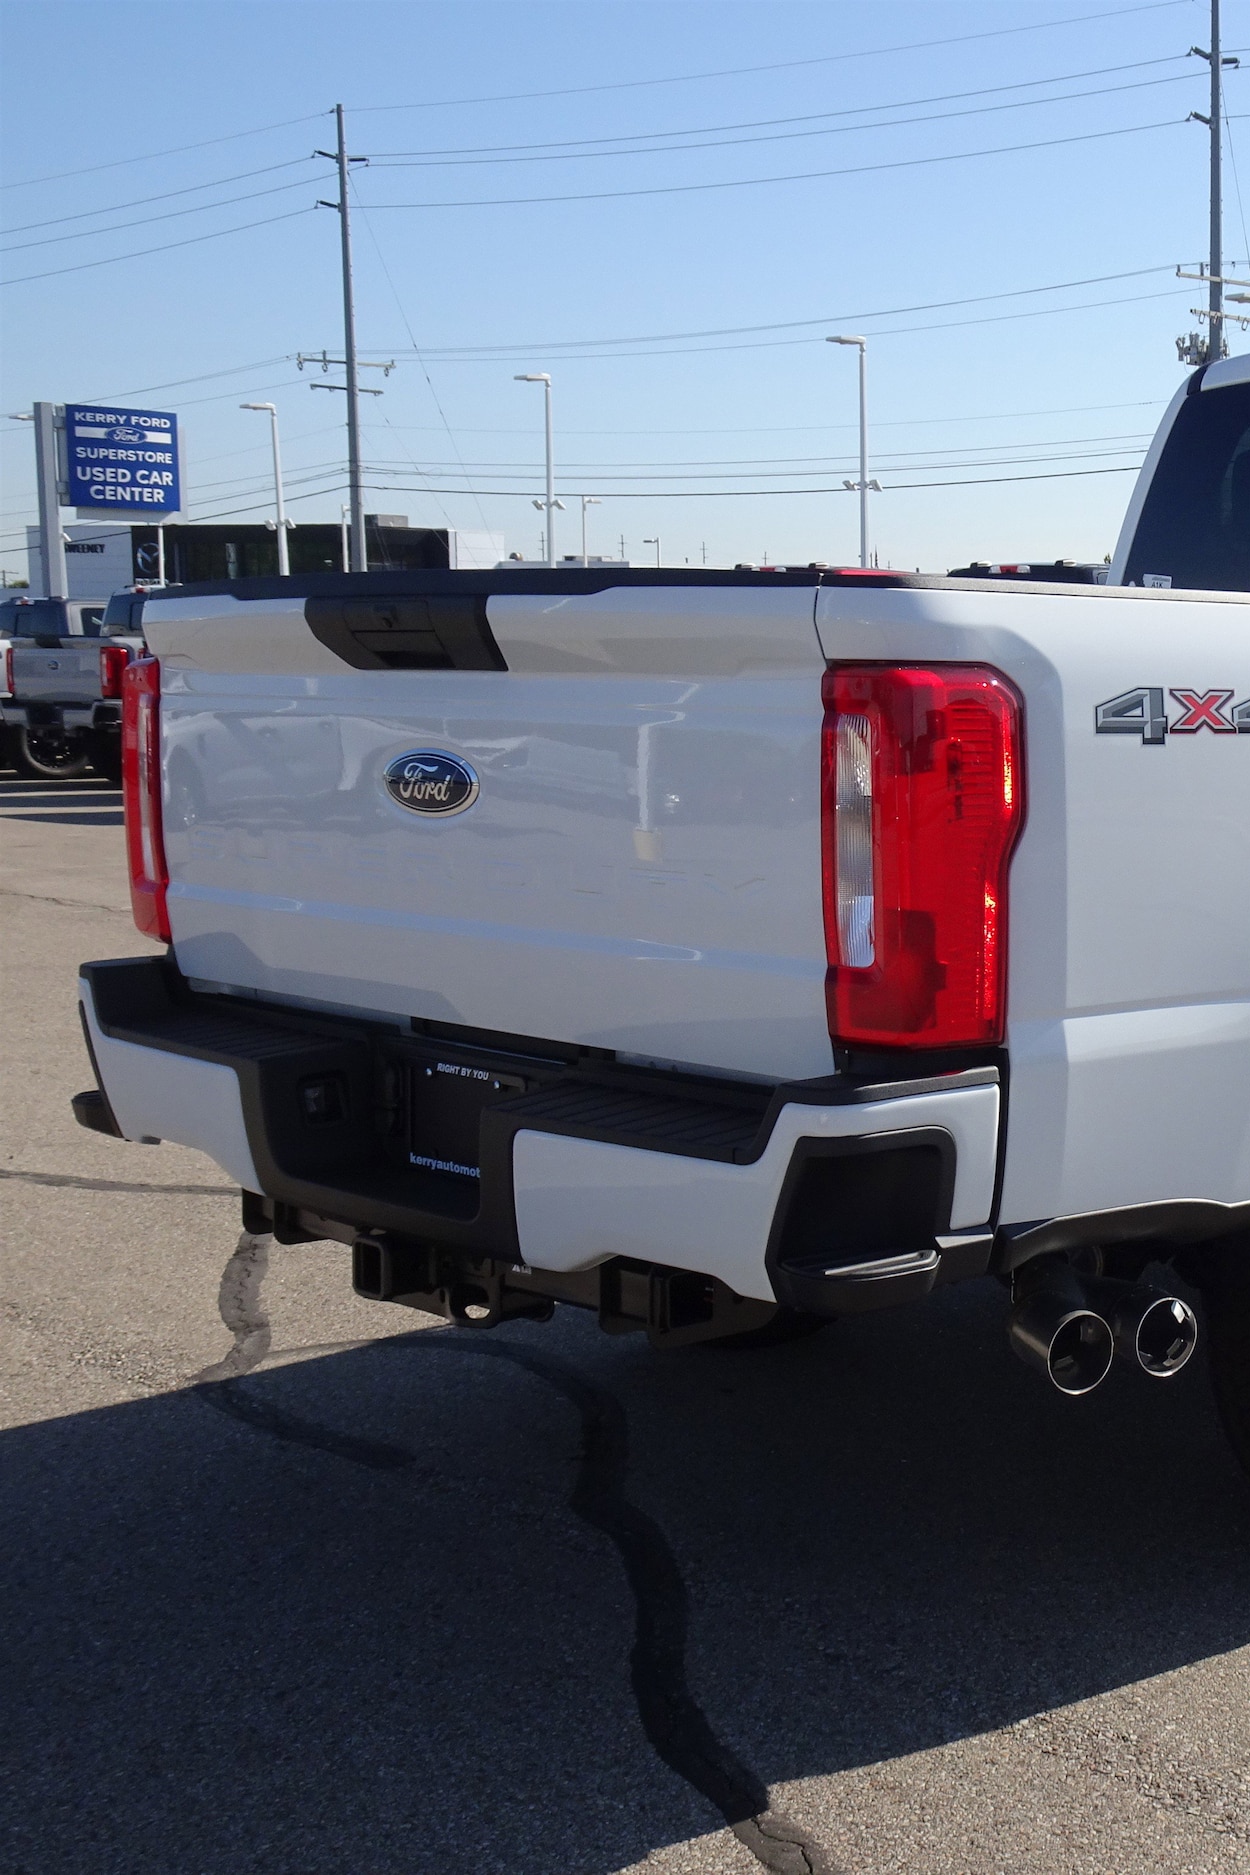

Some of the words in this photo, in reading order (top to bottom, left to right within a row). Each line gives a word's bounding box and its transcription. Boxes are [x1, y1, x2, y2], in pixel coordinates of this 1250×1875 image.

[74, 412, 127, 424] KERRY
[131, 416, 171, 428] FORD
[113, 428, 140, 442] Ford
[76, 447, 173, 464] SUPERSTORE
[76, 466, 132, 483] USED
[135, 470, 173, 486] CAR
[89, 485, 165, 503] CENTER
[400, 762, 453, 801] Ford
[436, 1063, 461, 1076] RIGHT
[460, 1067, 472, 1078] BY
[472, 1070, 490, 1081] YOU
